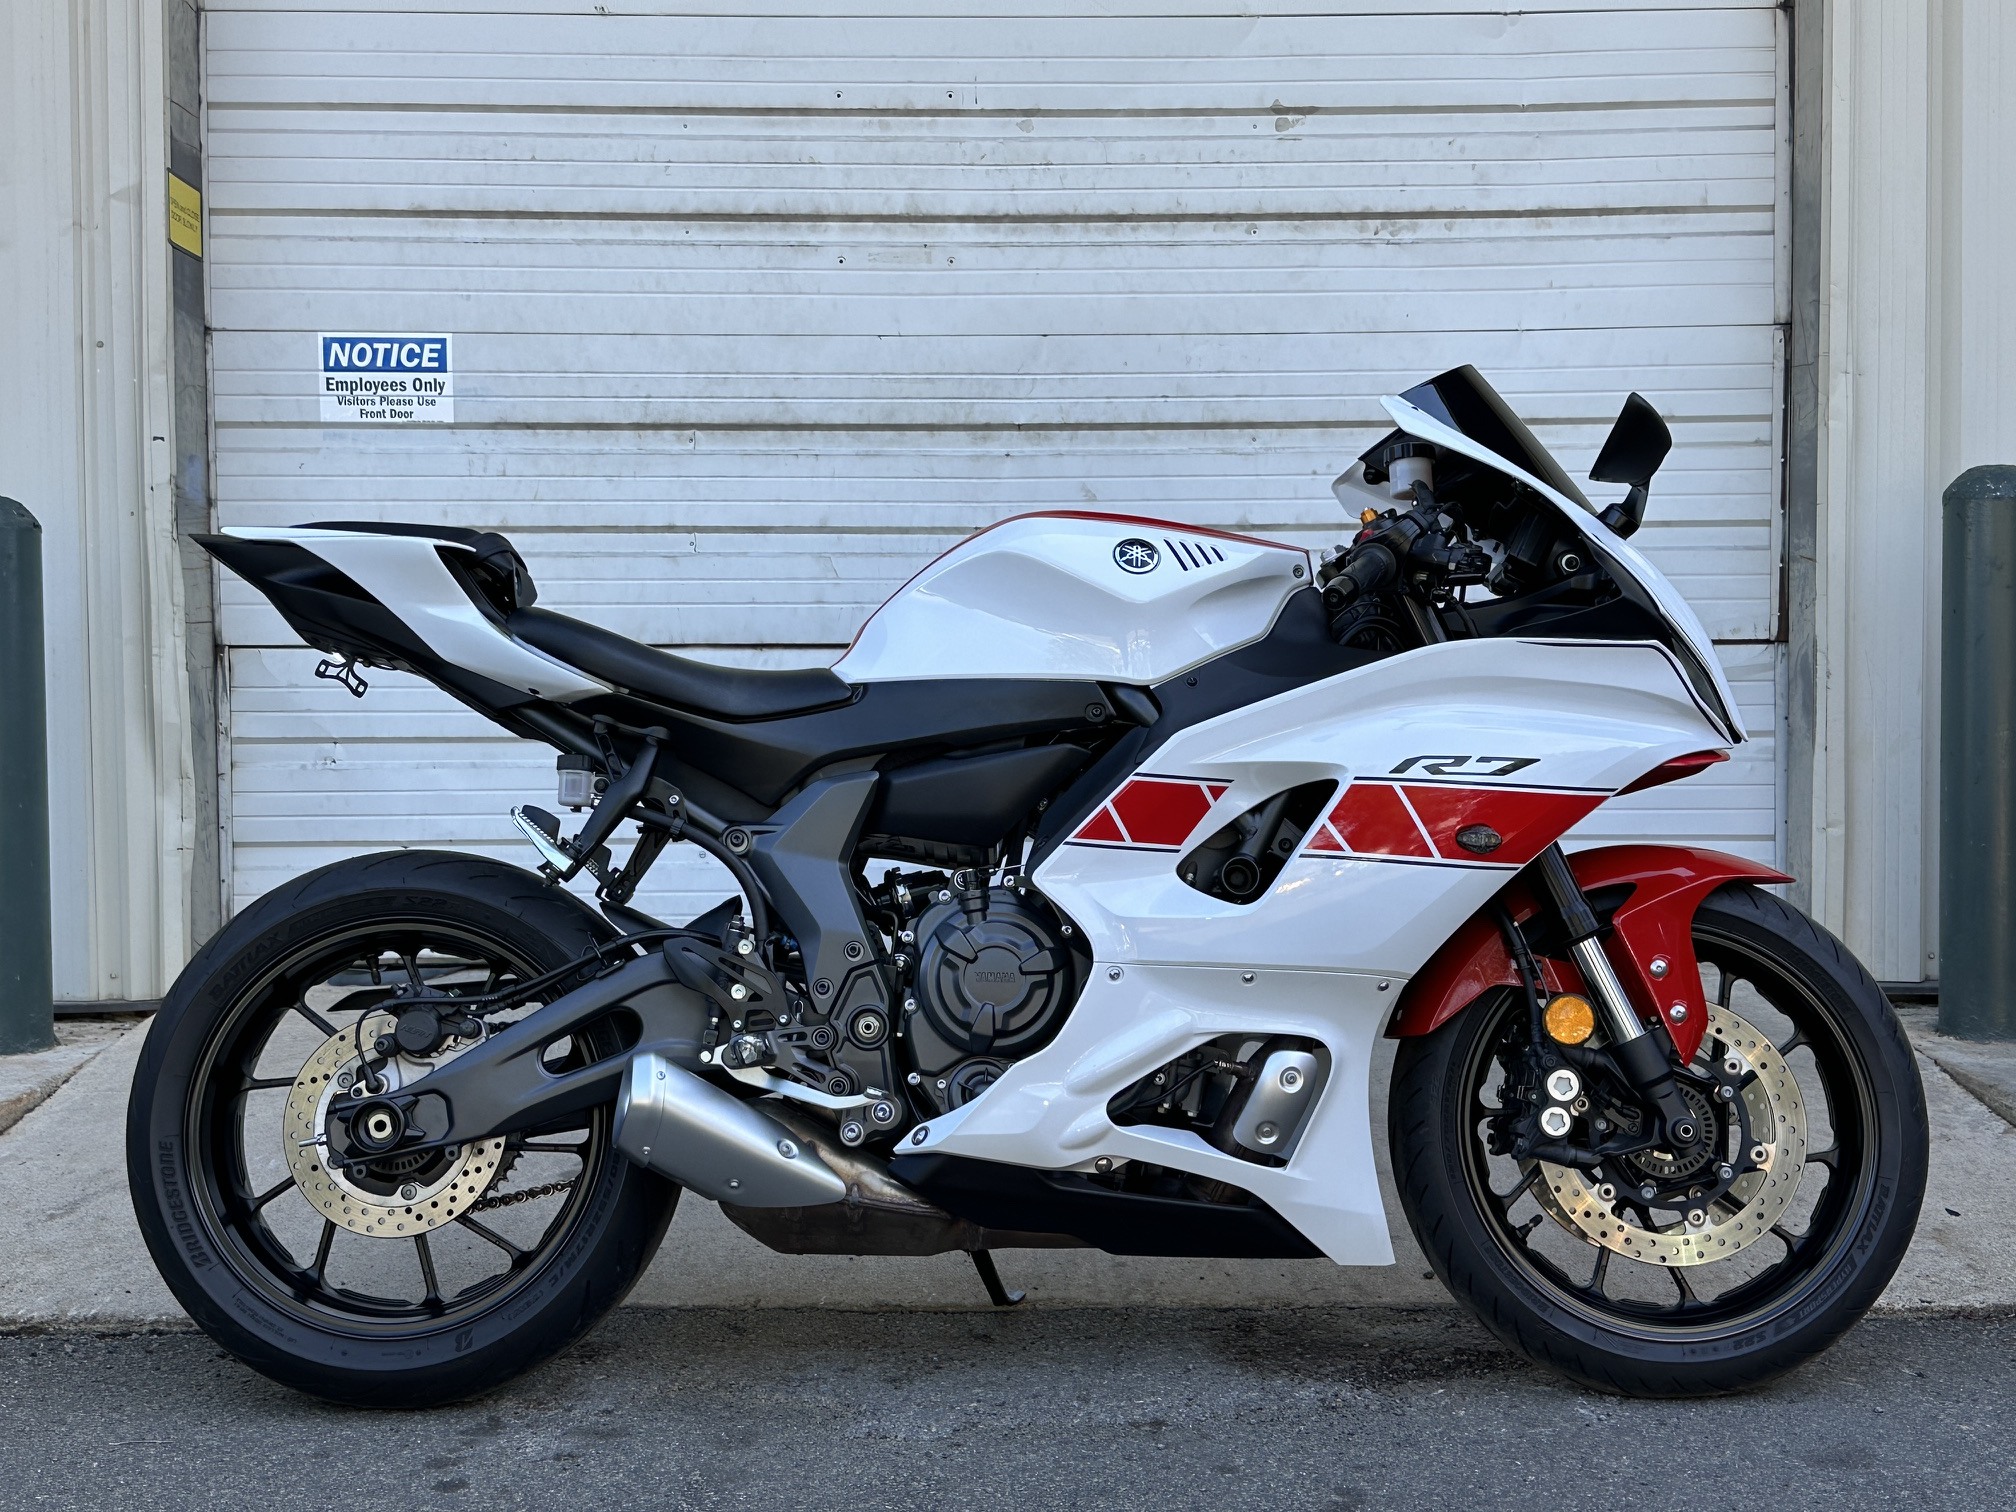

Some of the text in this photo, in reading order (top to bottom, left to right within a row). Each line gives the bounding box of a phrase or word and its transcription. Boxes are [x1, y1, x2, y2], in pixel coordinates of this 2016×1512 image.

[329, 343, 442, 368] NOTICE
[326, 377, 446, 395] Employees Only
[336, 396, 436, 406] Visitors Please Use
[360, 409, 414, 419] Front Door
[1388, 755, 1541, 776] R7
[974, 971, 1016, 983] YAMAHA
[159, 1140, 213, 1268] BRIDGESTONE
[1733, 1183, 1890, 1351] BATTLAX HYPERSPORT S22
